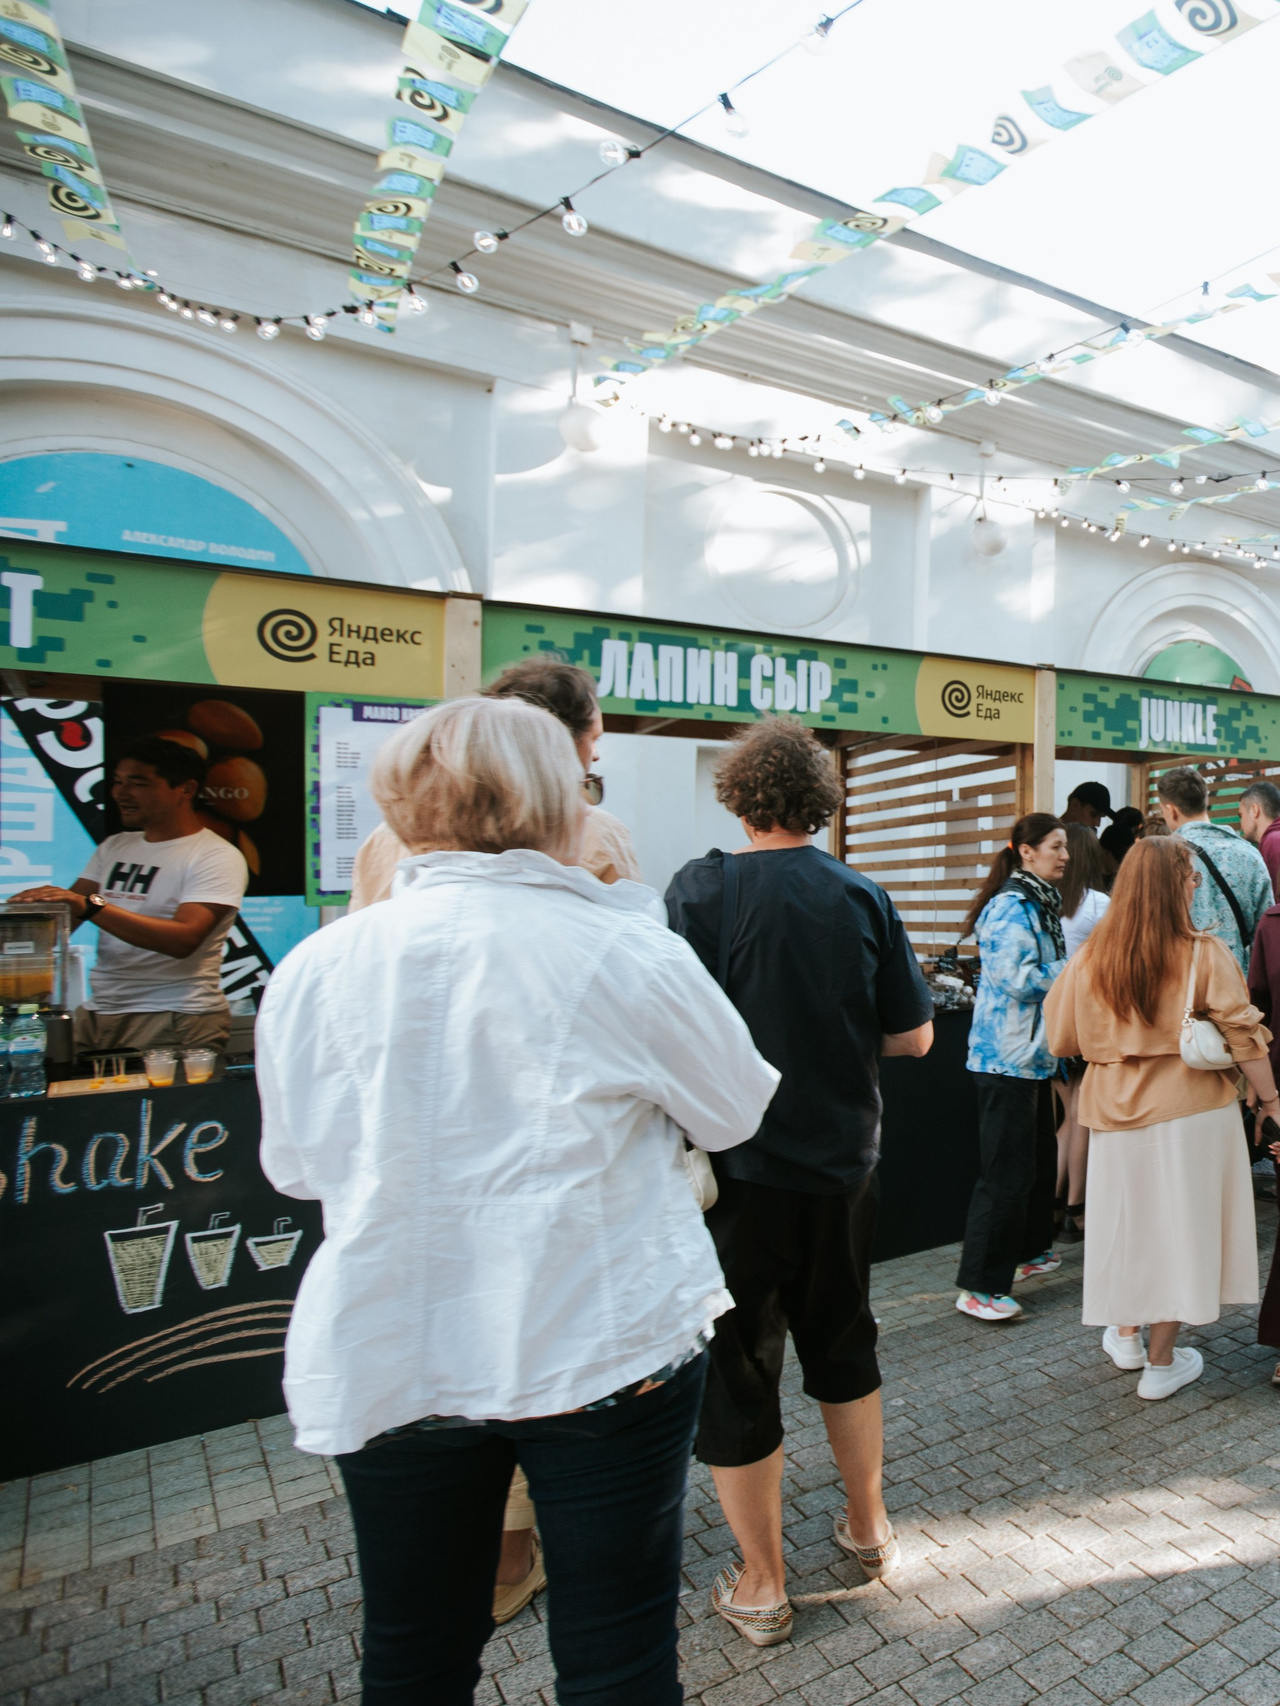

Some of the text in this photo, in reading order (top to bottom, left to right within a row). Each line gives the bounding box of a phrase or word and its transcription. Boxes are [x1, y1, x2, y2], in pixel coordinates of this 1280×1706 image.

[327, 617, 423, 646] Яндекс
[327, 643, 376, 668] Еда
[597, 638, 832, 714] ЛАПИН СЫР
[975, 684, 1025, 705] Яндекс
[975, 703, 1001, 721] Еда
[1139, 697, 1218, 749] JUNKLE
[105, 861, 161, 895] HH
[0, 1099, 229, 1204] hake
